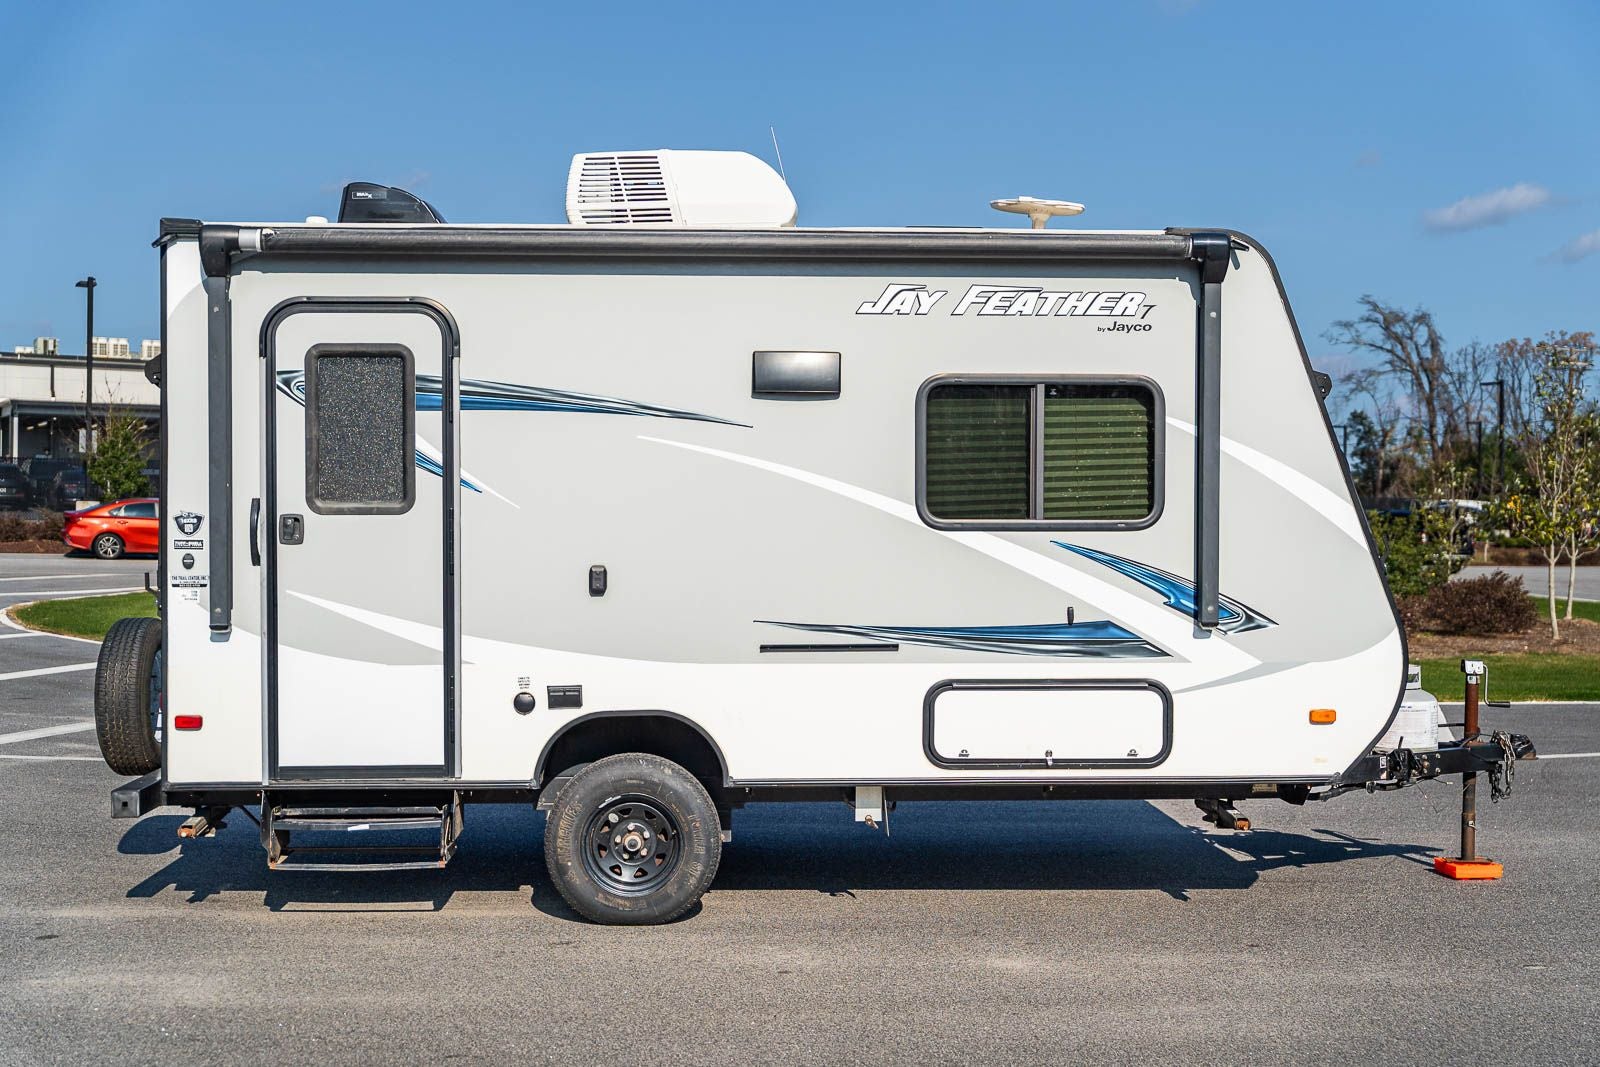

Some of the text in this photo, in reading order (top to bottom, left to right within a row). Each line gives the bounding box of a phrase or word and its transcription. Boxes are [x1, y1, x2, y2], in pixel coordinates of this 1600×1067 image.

[855, 283, 949, 315] JAY
[950, 284, 1146, 316] FEATHER
[1097, 320, 1153, 334] by Jayco
